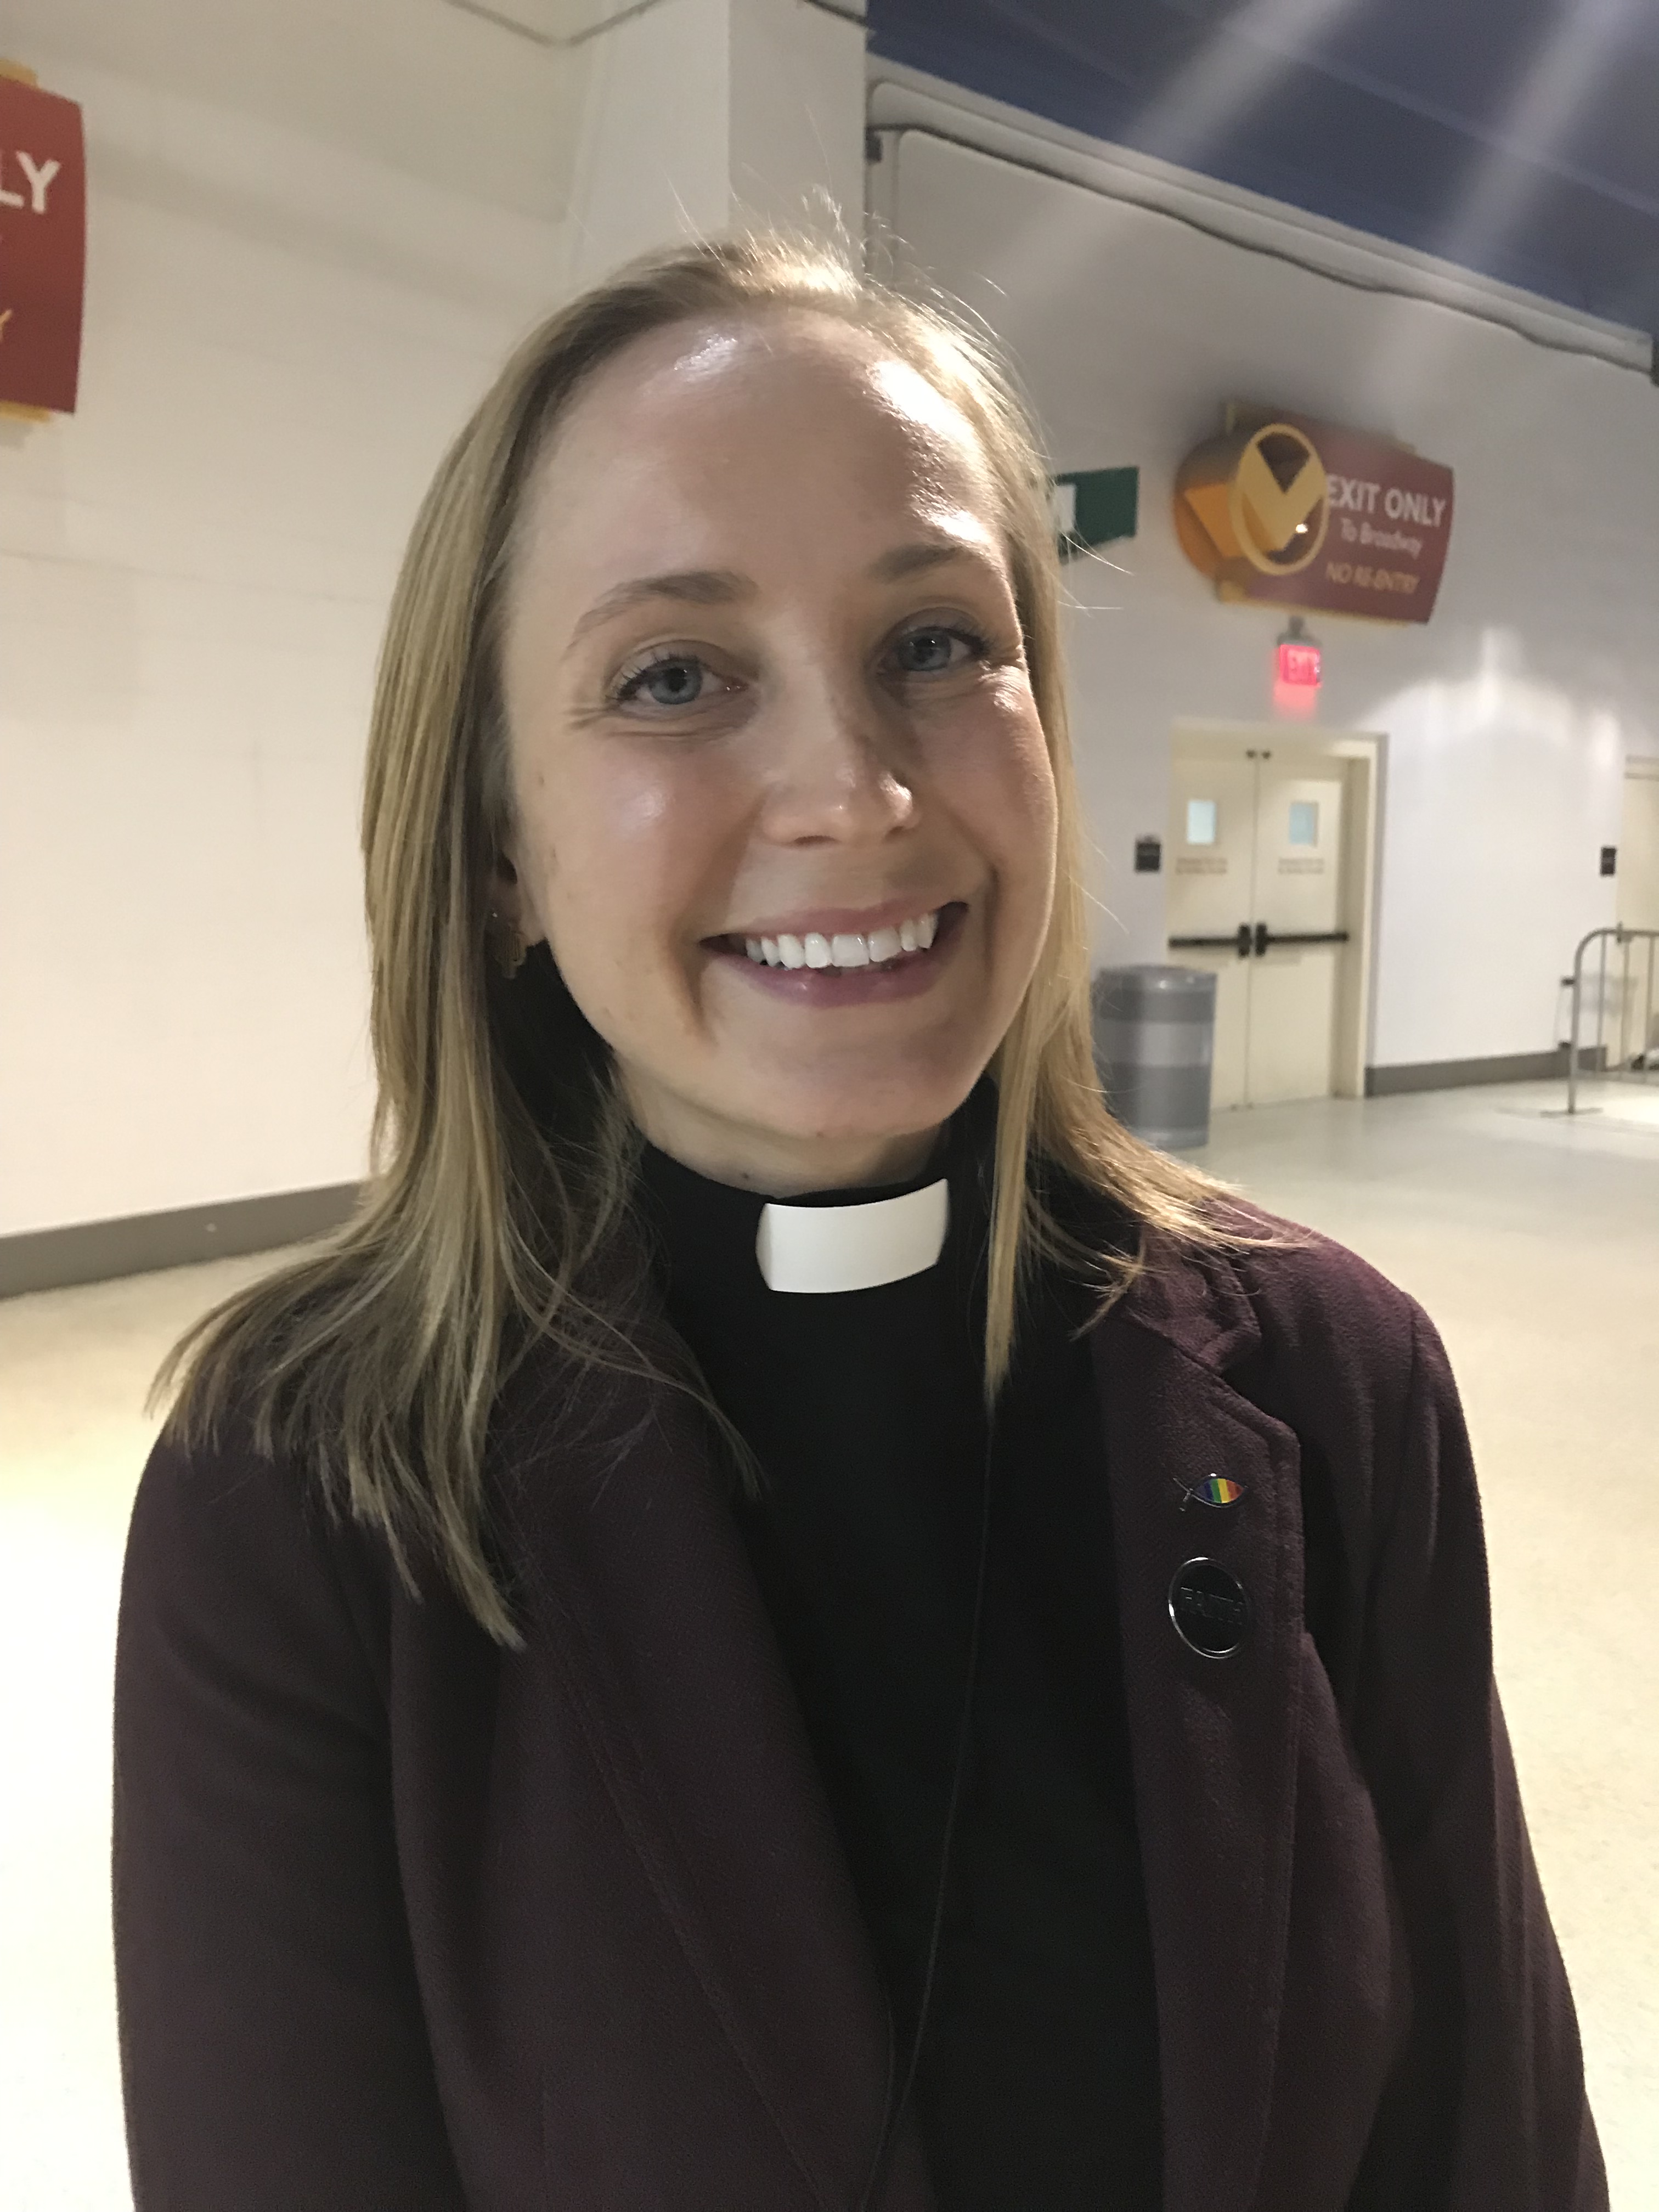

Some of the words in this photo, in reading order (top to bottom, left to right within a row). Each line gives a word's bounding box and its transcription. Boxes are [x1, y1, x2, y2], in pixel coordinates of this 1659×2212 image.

[1328, 474, 1380, 513] EXIT
[1385, 487, 1446, 527] ONLY
[1340, 517, 1357, 542] To
[1326, 561, 1352, 584] NO
